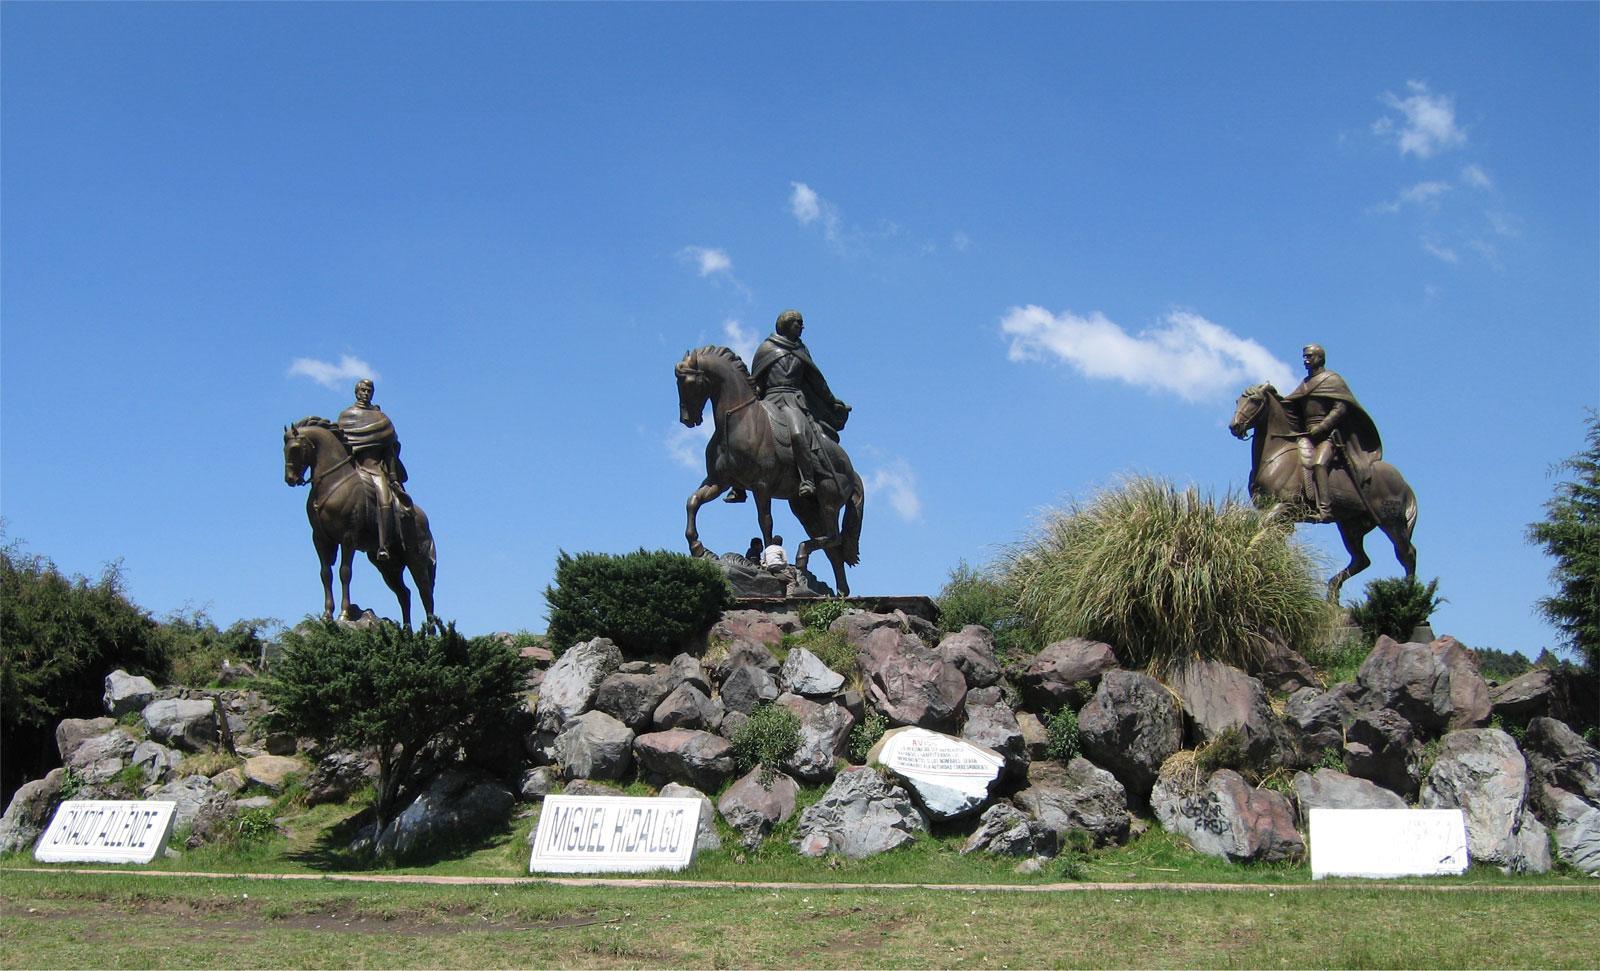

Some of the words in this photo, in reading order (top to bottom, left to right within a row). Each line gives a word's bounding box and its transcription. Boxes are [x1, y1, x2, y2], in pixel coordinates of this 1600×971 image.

[50, 810, 104, 845] IGNACIO
[93, 810, 158, 847] ALLENDE
[546, 806, 606, 852] MIGUEL
[610, 807, 684, 853] HIDALGO
